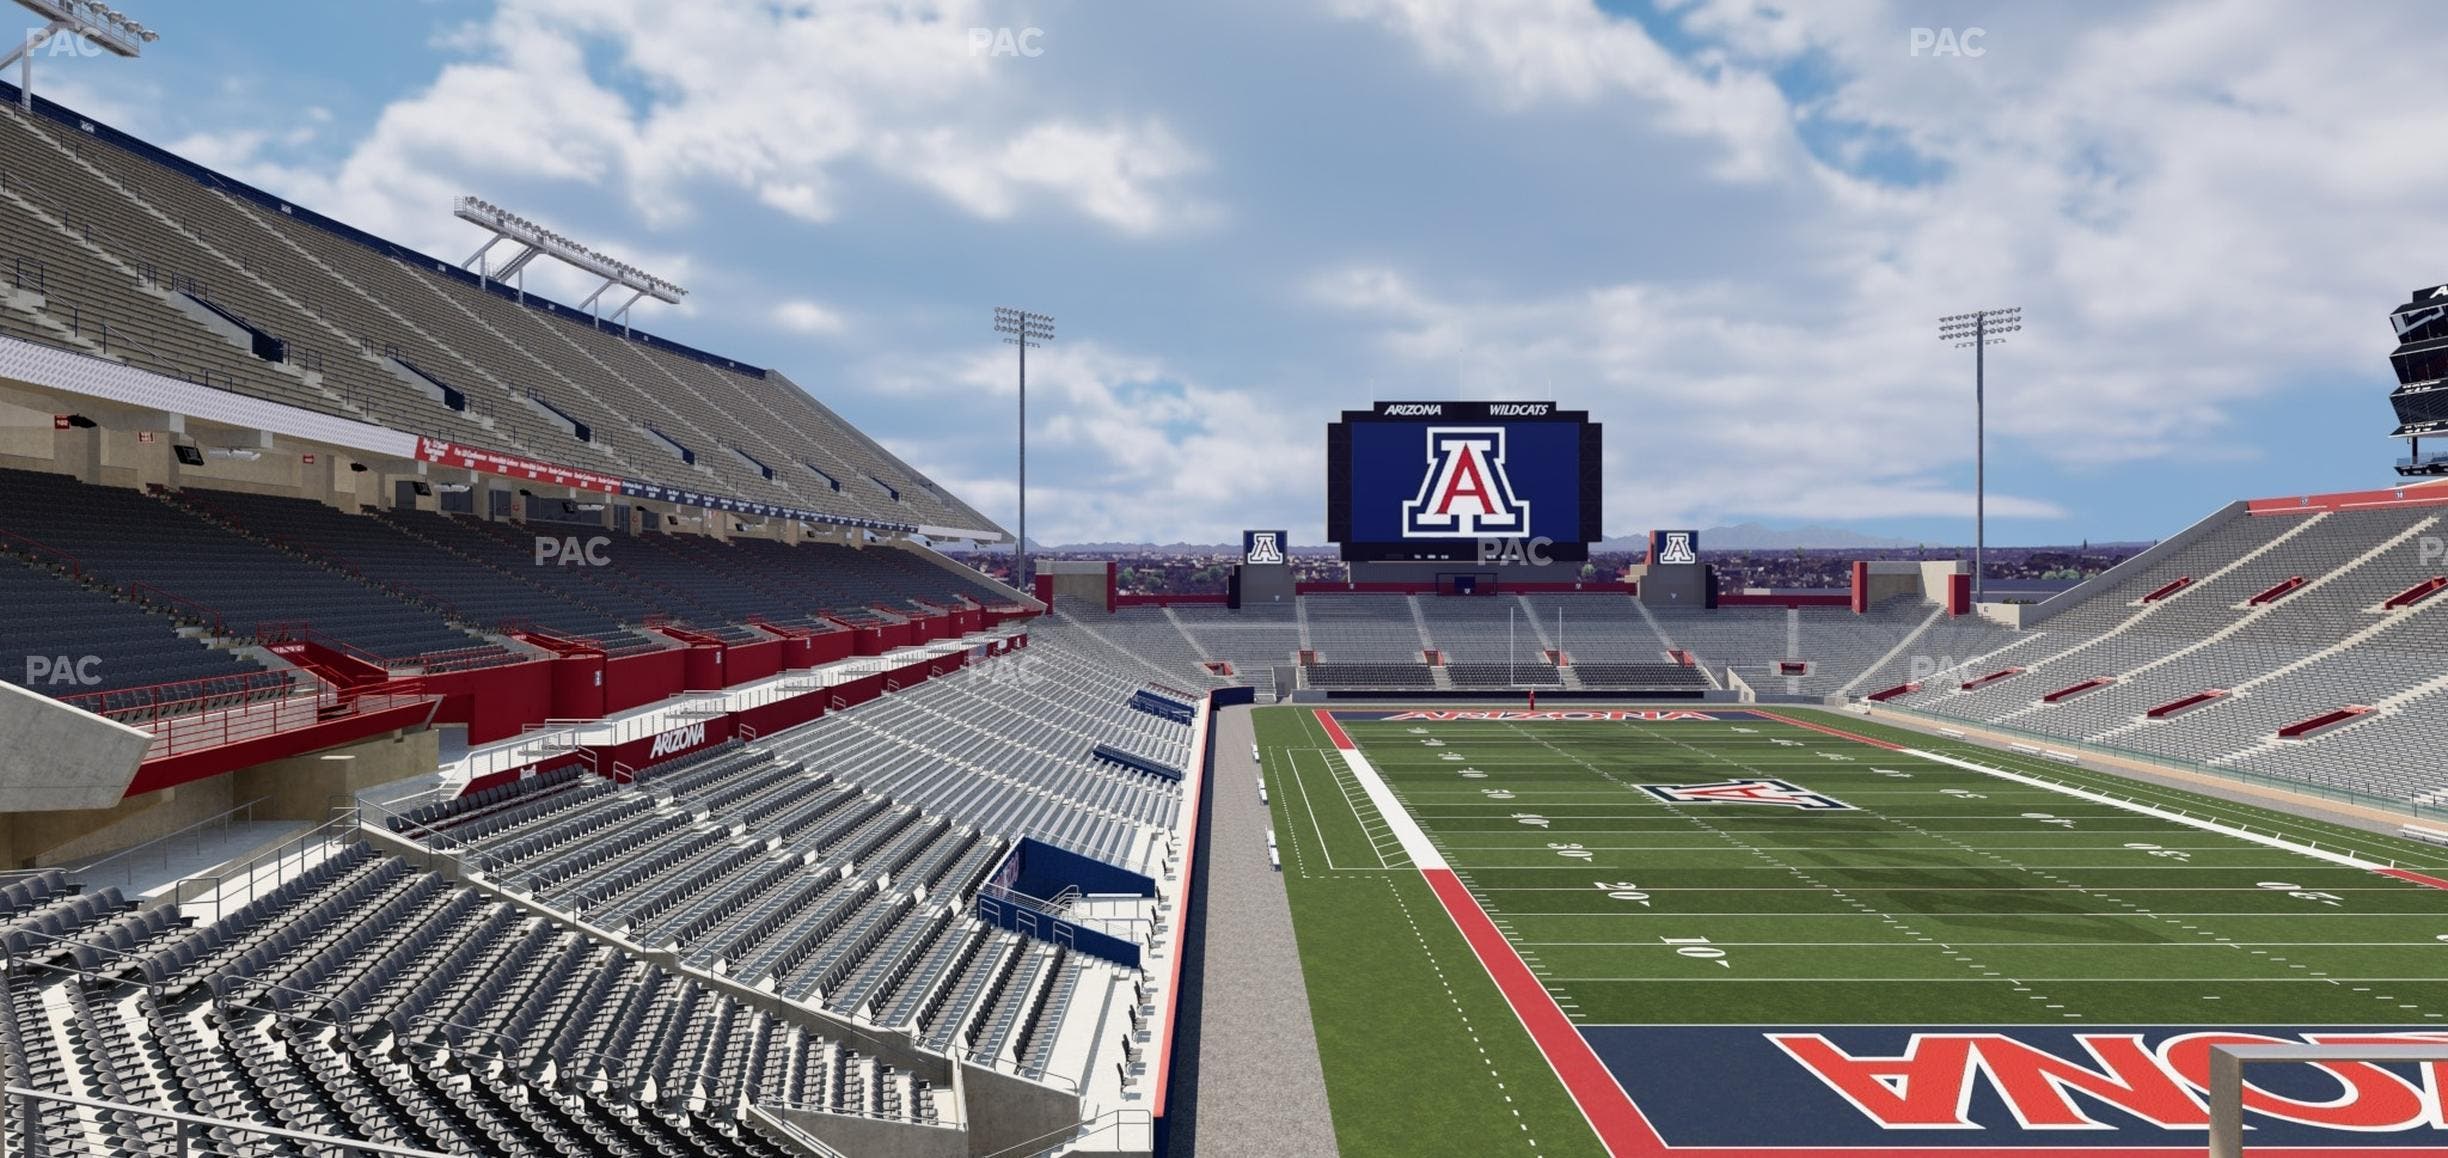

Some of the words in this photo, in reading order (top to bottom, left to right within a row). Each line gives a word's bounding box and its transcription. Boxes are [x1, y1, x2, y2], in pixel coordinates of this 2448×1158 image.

[1384, 404, 1442, 416] ARIZONA
[1489, 404, 1548, 416] WILDCATS
[1402, 427, 1530, 538] A
[1247, 533, 1283, 564] A
[1660, 533, 1696, 564] A
[1380, 711, 1721, 721] ARIZONA
[650, 722, 704, 759] ARIZONA
[1547, 843, 1594, 858] 30
[1594, 881, 1650, 900] 20
[1659, 935, 1727, 958] 10
